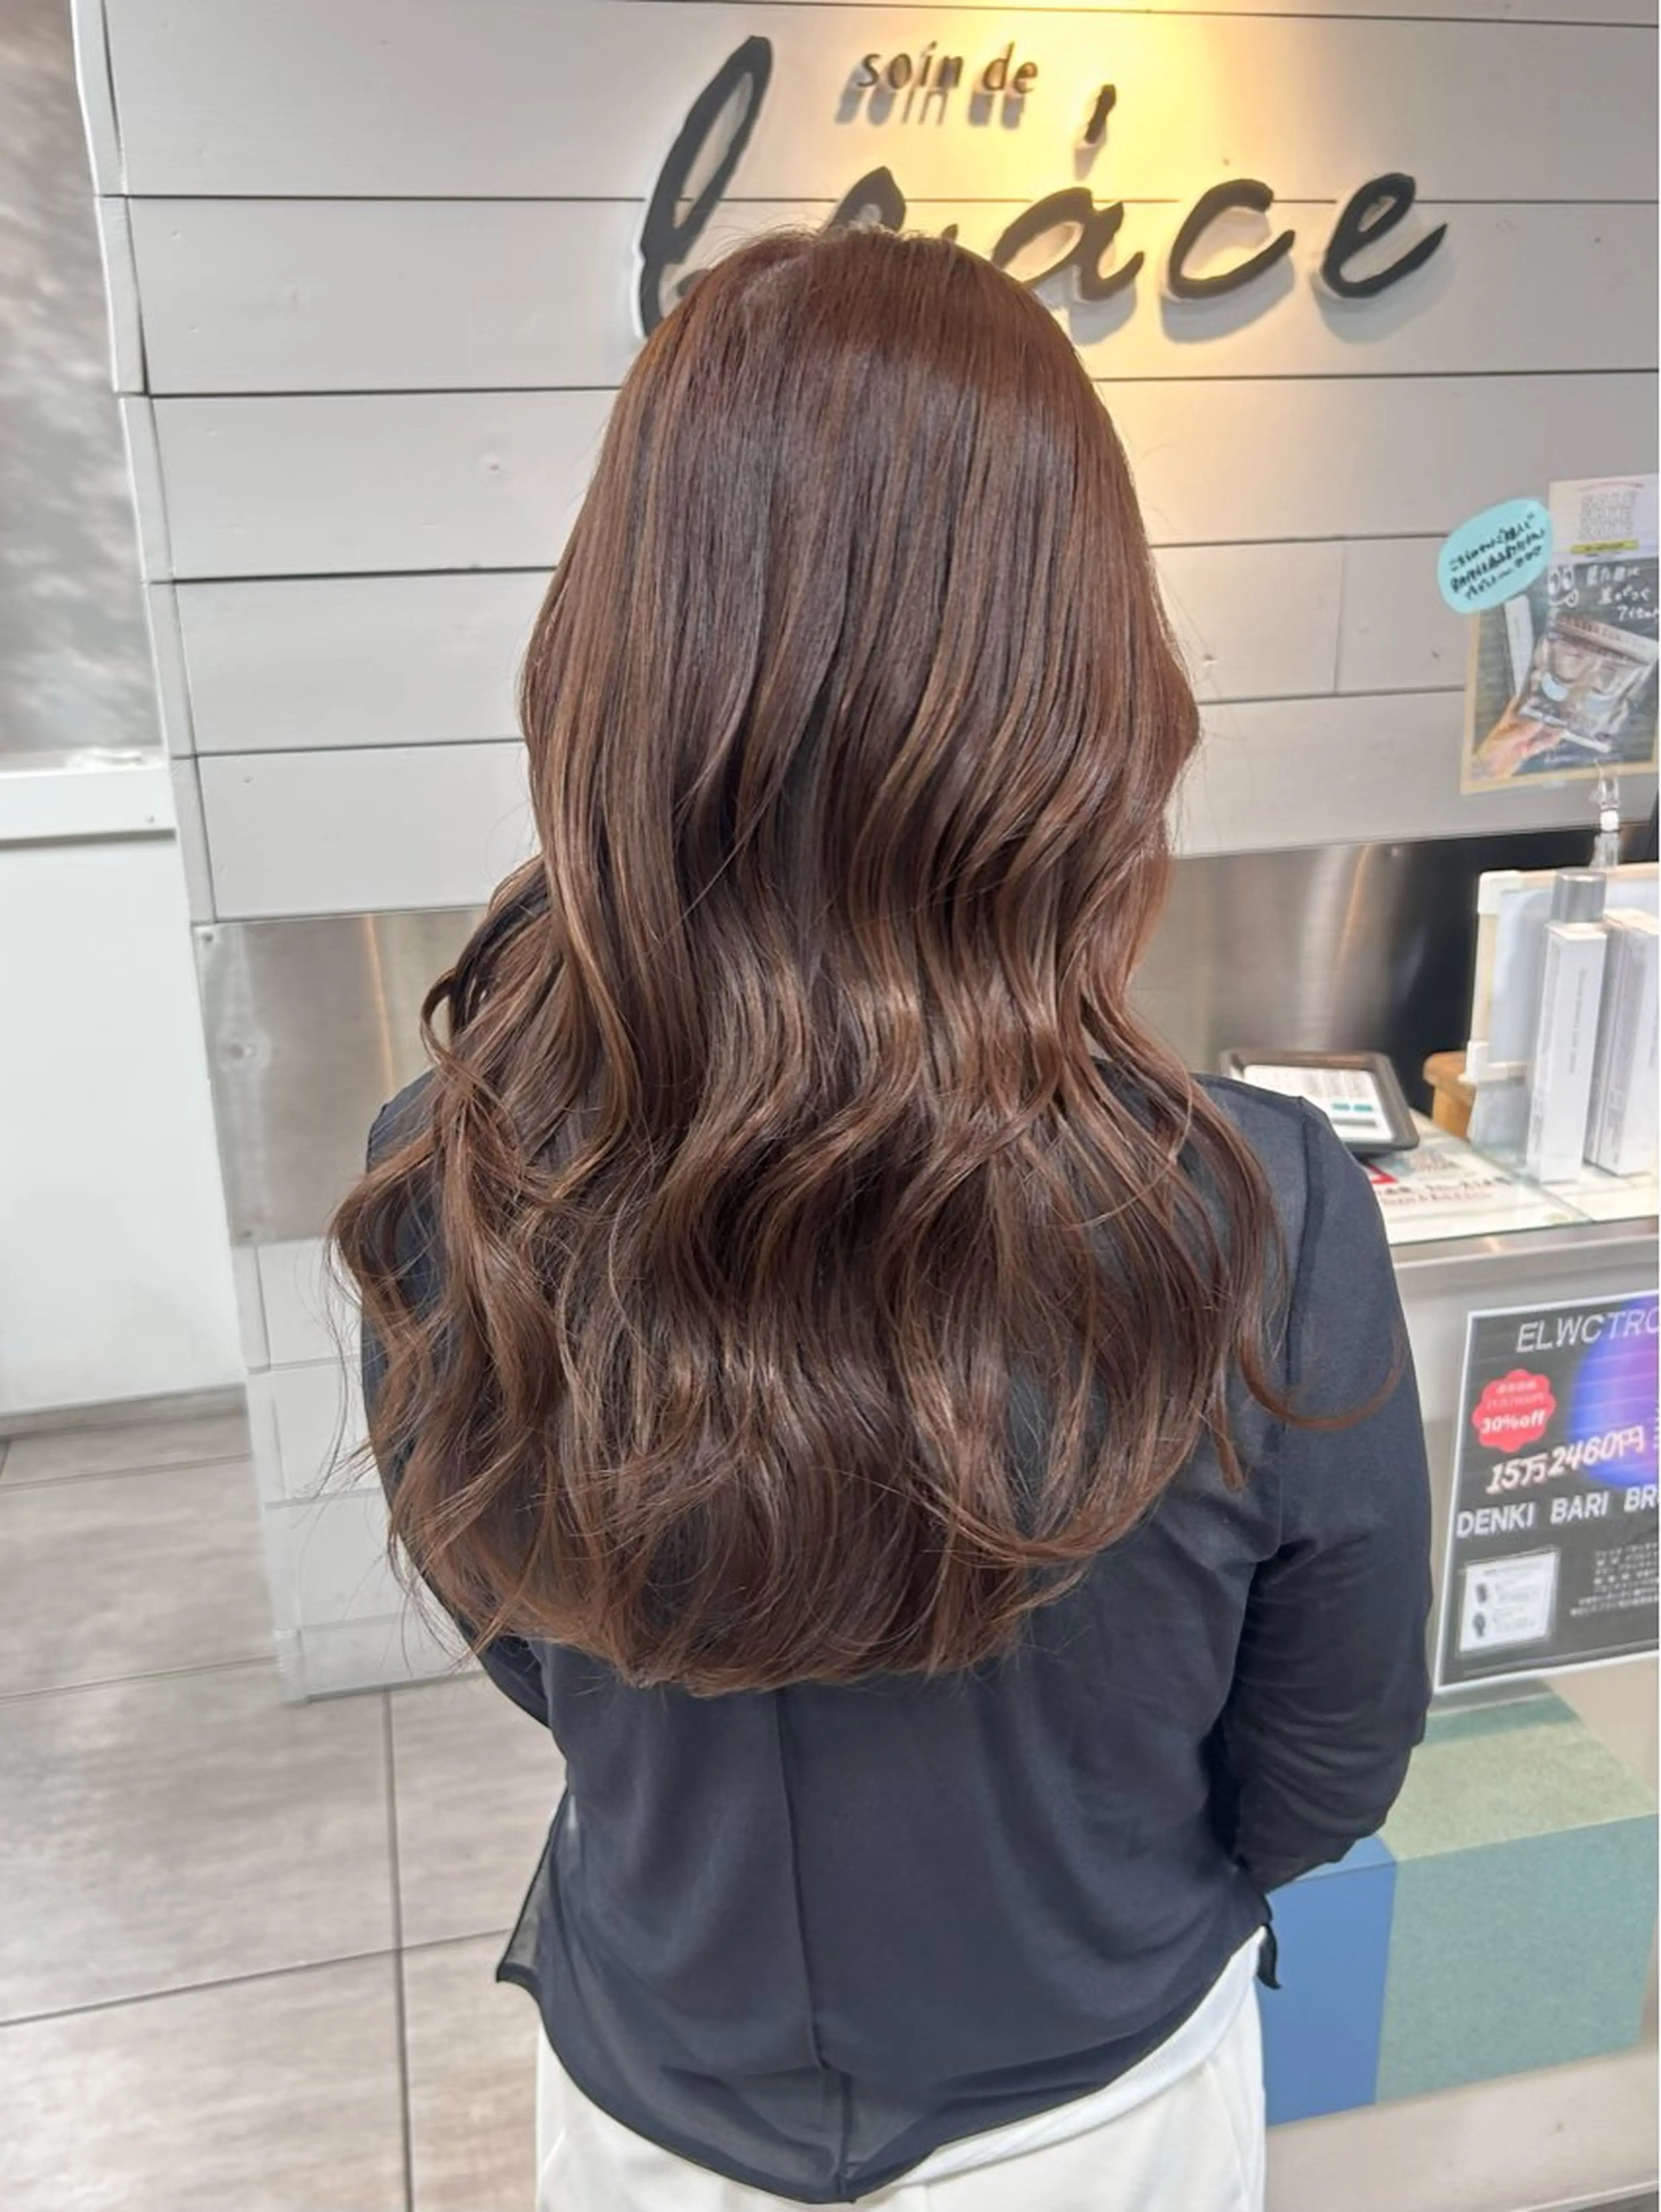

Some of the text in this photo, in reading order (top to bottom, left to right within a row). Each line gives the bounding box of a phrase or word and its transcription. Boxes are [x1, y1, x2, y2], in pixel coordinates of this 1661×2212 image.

[857, 42, 1039, 94] soin de
[1456, 1484, 1658, 1537] DENKI BARI BR
